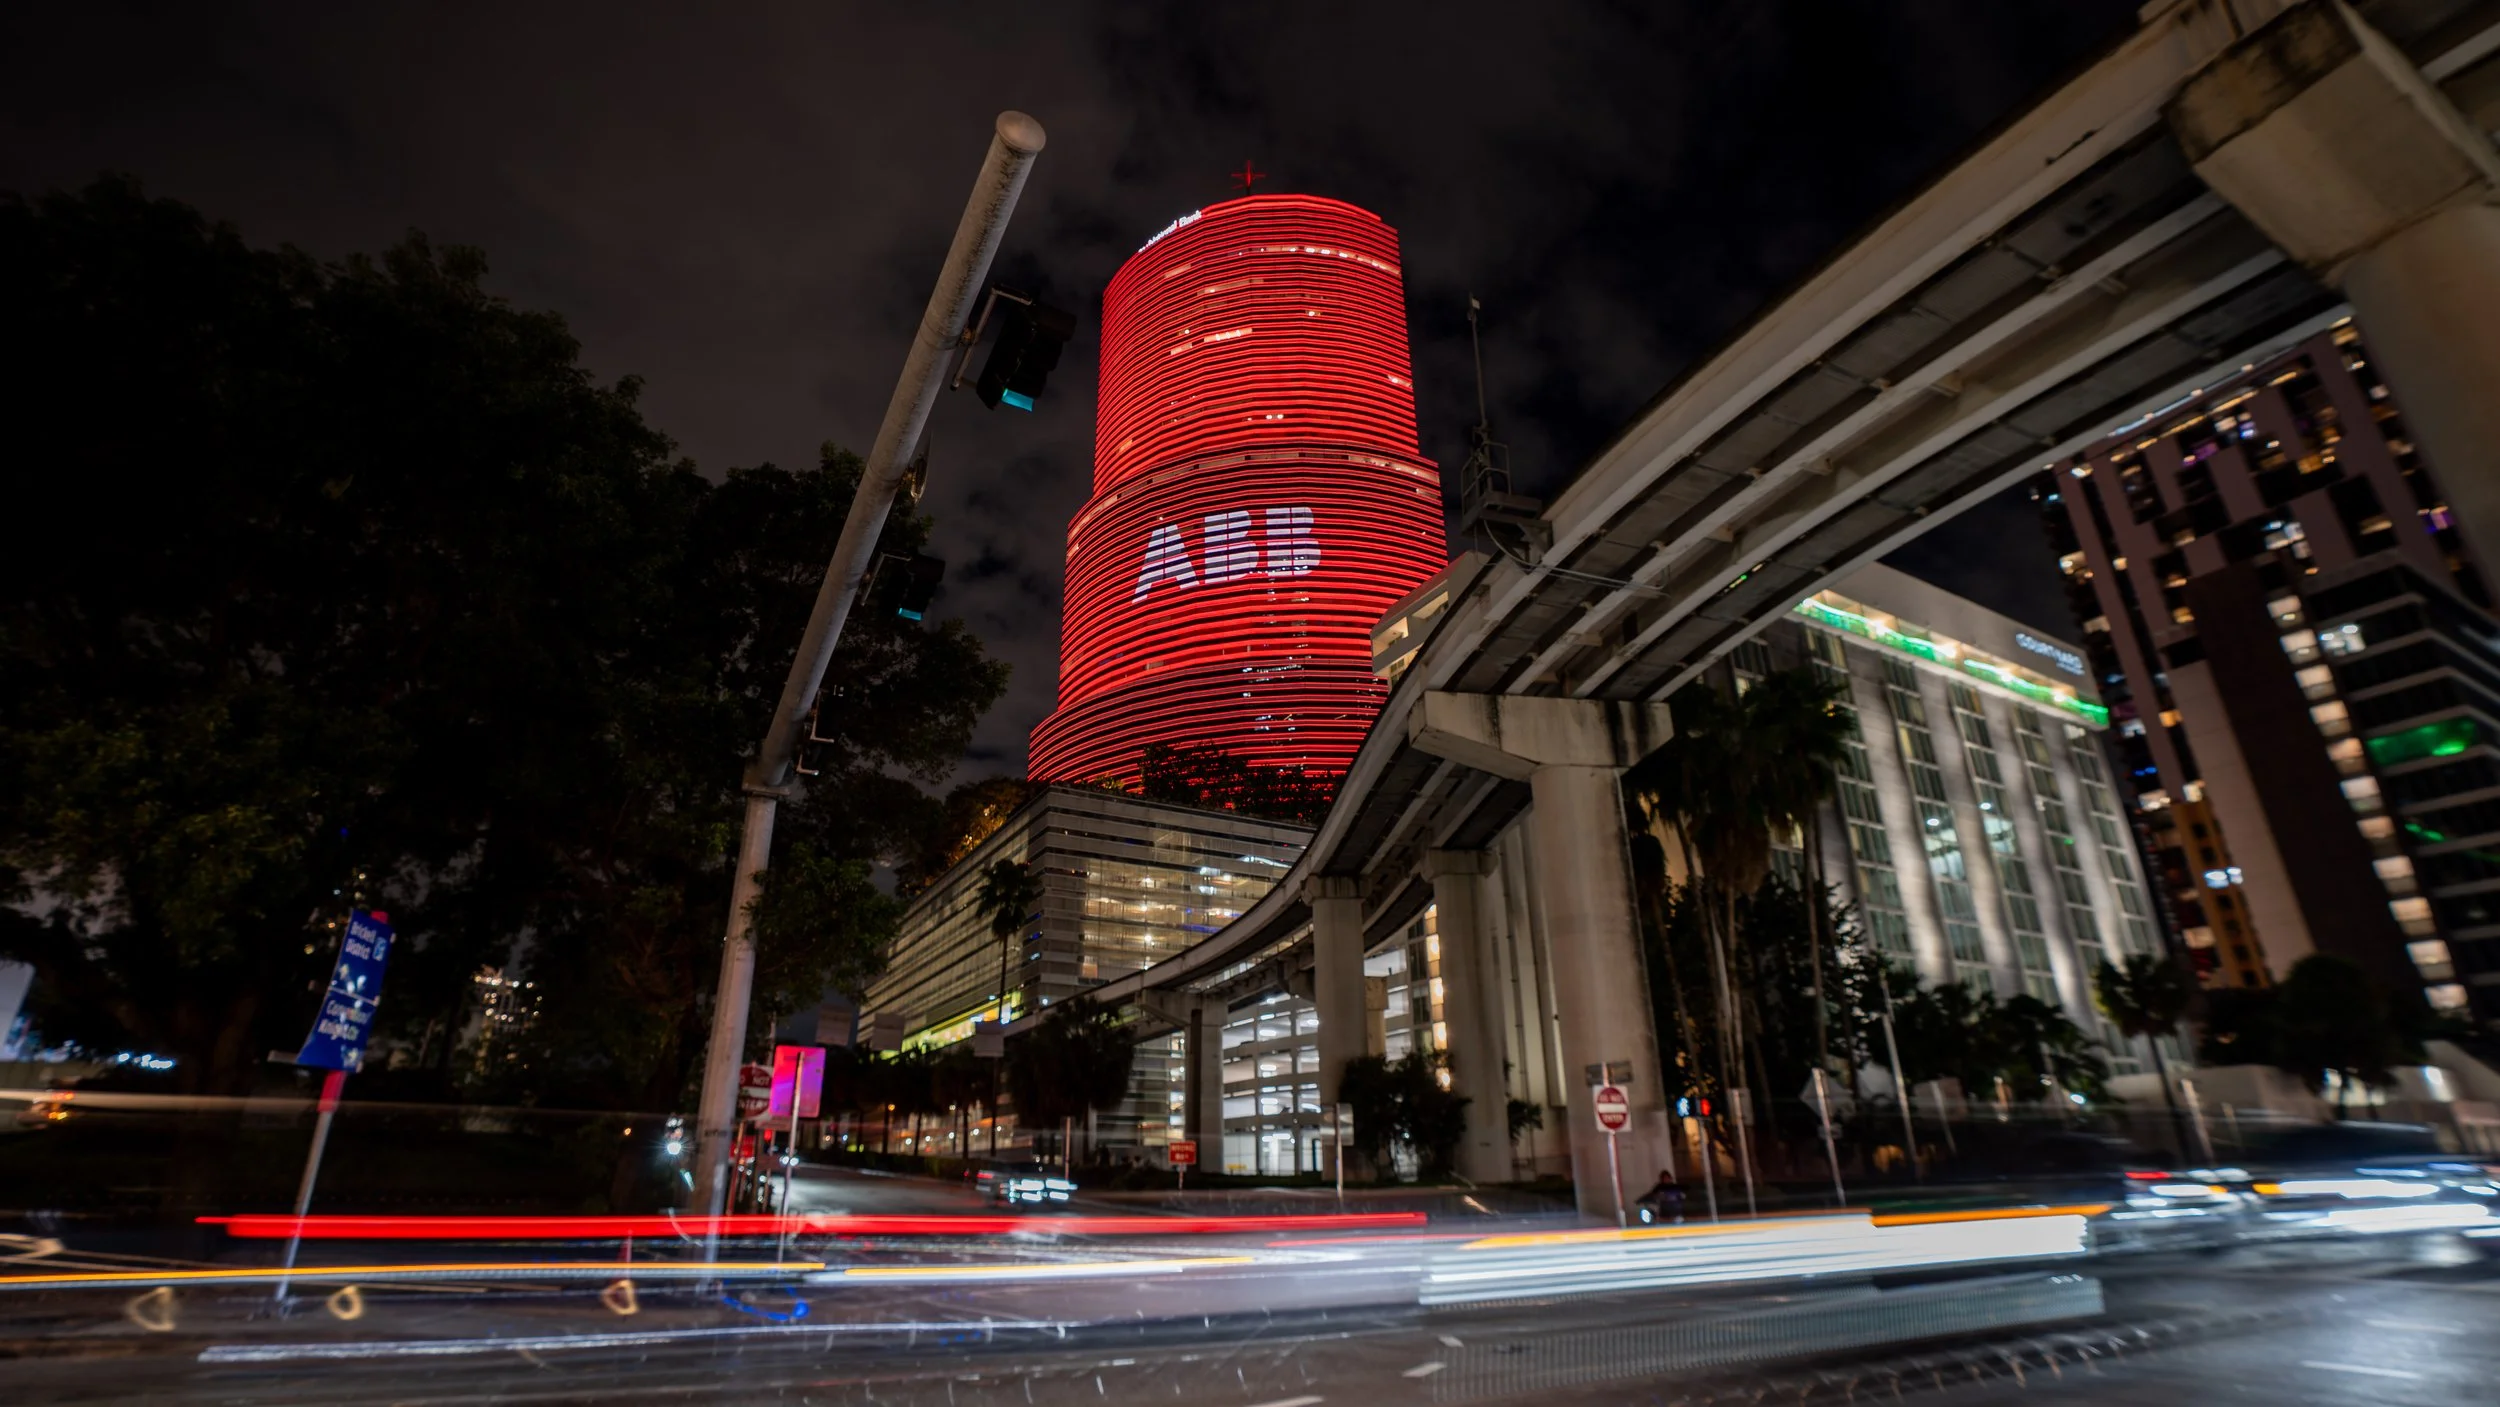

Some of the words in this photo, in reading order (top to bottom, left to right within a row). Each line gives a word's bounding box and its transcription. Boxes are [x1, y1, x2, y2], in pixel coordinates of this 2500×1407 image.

[1179, 209, 1202, 228] Bank
[1132, 506, 1322, 604] ABB
[752, 1075, 770, 1086] NOT
[738, 1099, 769, 1111] NTER
